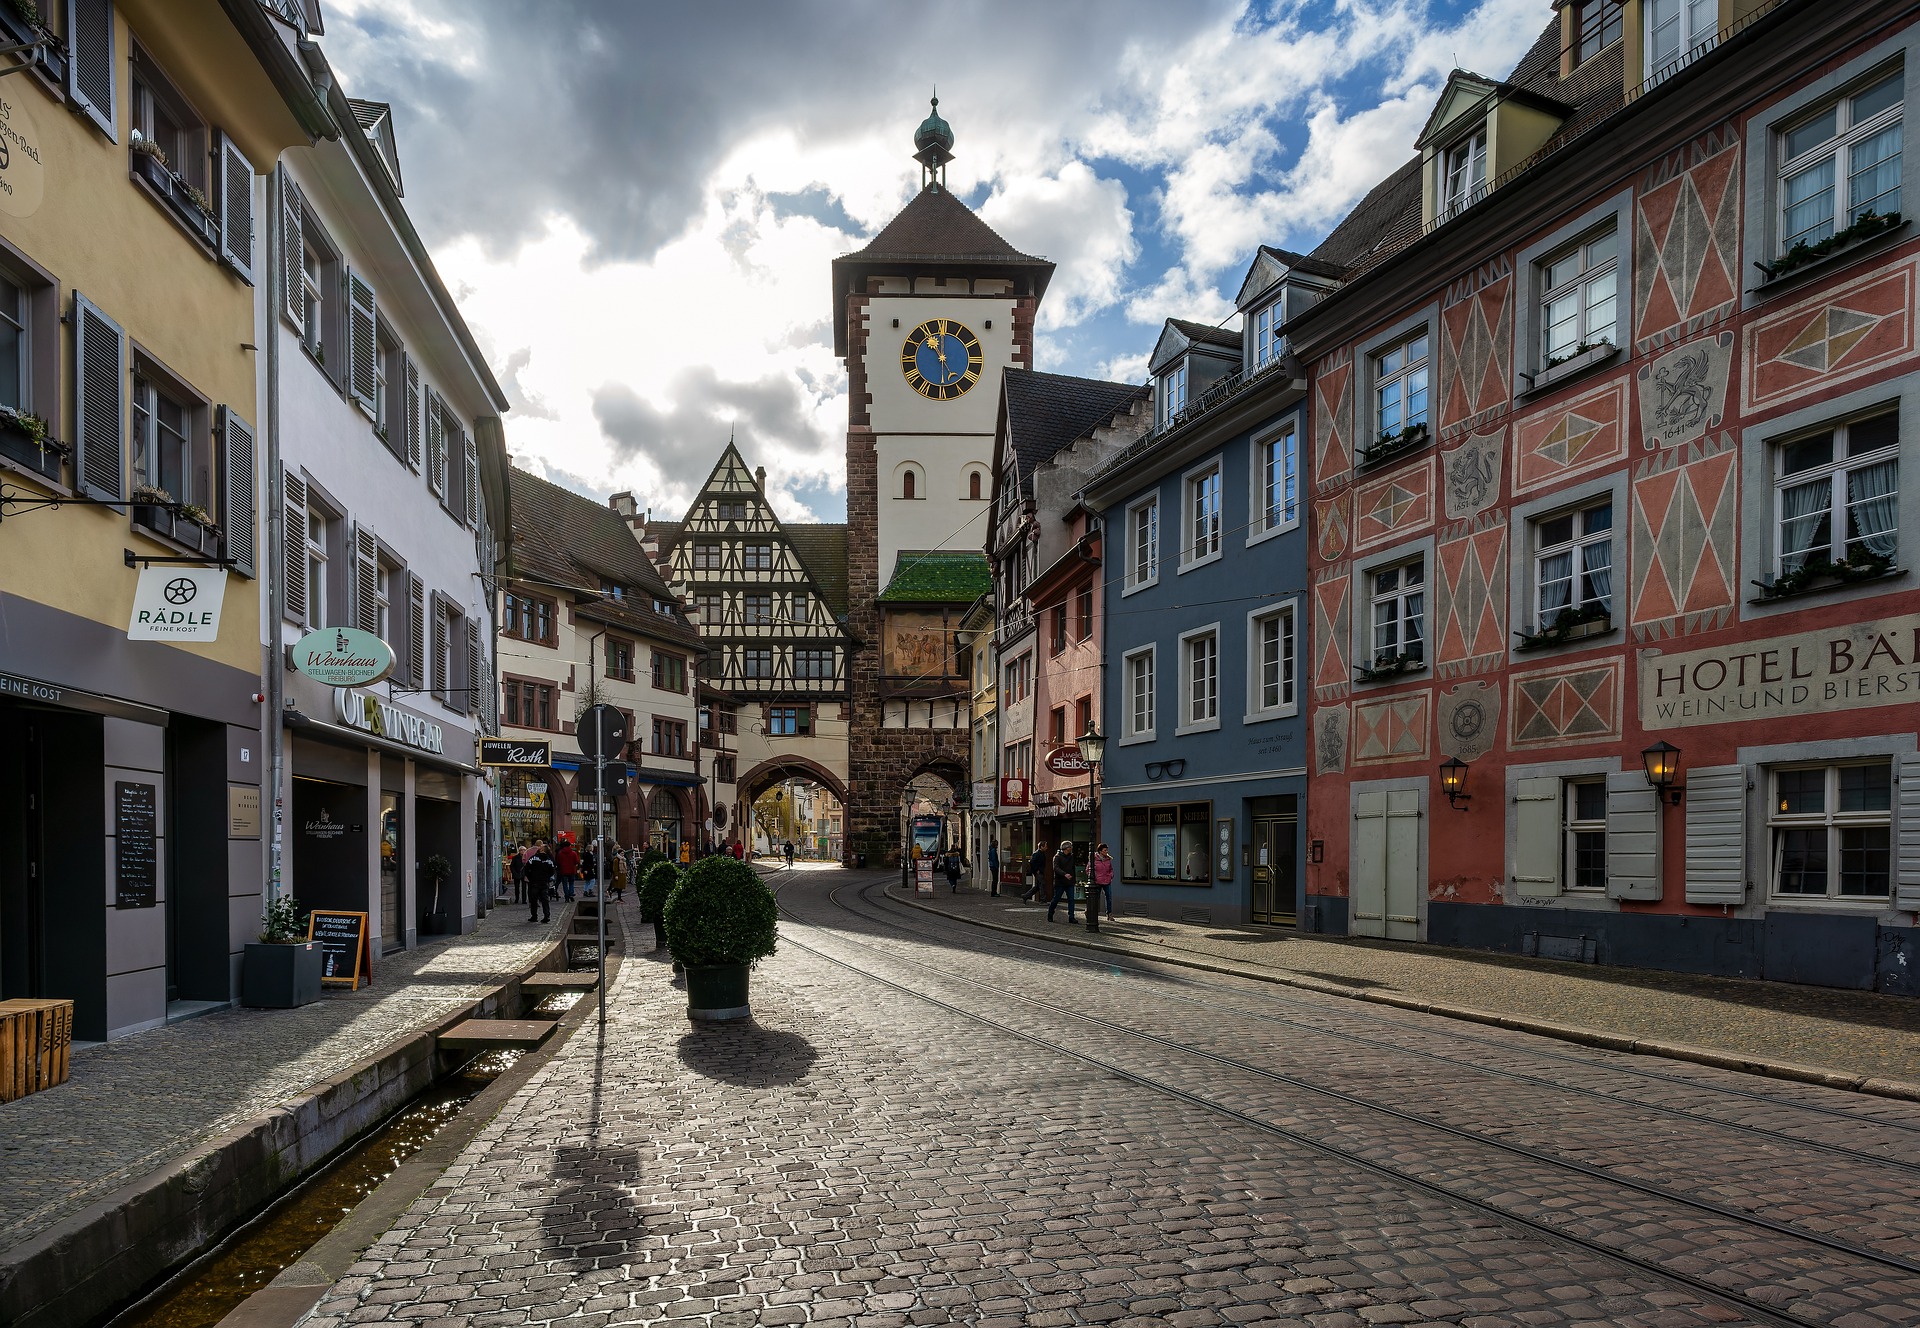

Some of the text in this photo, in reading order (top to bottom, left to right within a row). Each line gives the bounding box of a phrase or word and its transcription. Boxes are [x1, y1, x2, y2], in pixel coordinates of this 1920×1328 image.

[1662, 424, 1685, 440] 1641
[1454, 500, 1469, 511] 1651
[138, 607, 213, 625] RÄDLE
[307, 650, 378, 667] Weinhaus
[308, 668, 375, 676] STELLWAGEN-BÜCHNER
[1656, 646, 1813, 697] HOTEL
[33, 685, 61, 701] KOST
[507, 747, 544, 763] Rath
[305, 820, 344, 830] Weinhaus
[1125, 811, 1208, 824] BRILLEN OPTIK SEIFERT
[43, 1018, 51, 1053] Wein
[54, 1016, 62, 1050] Wein
[64, 1013, 72, 1048] Wein
